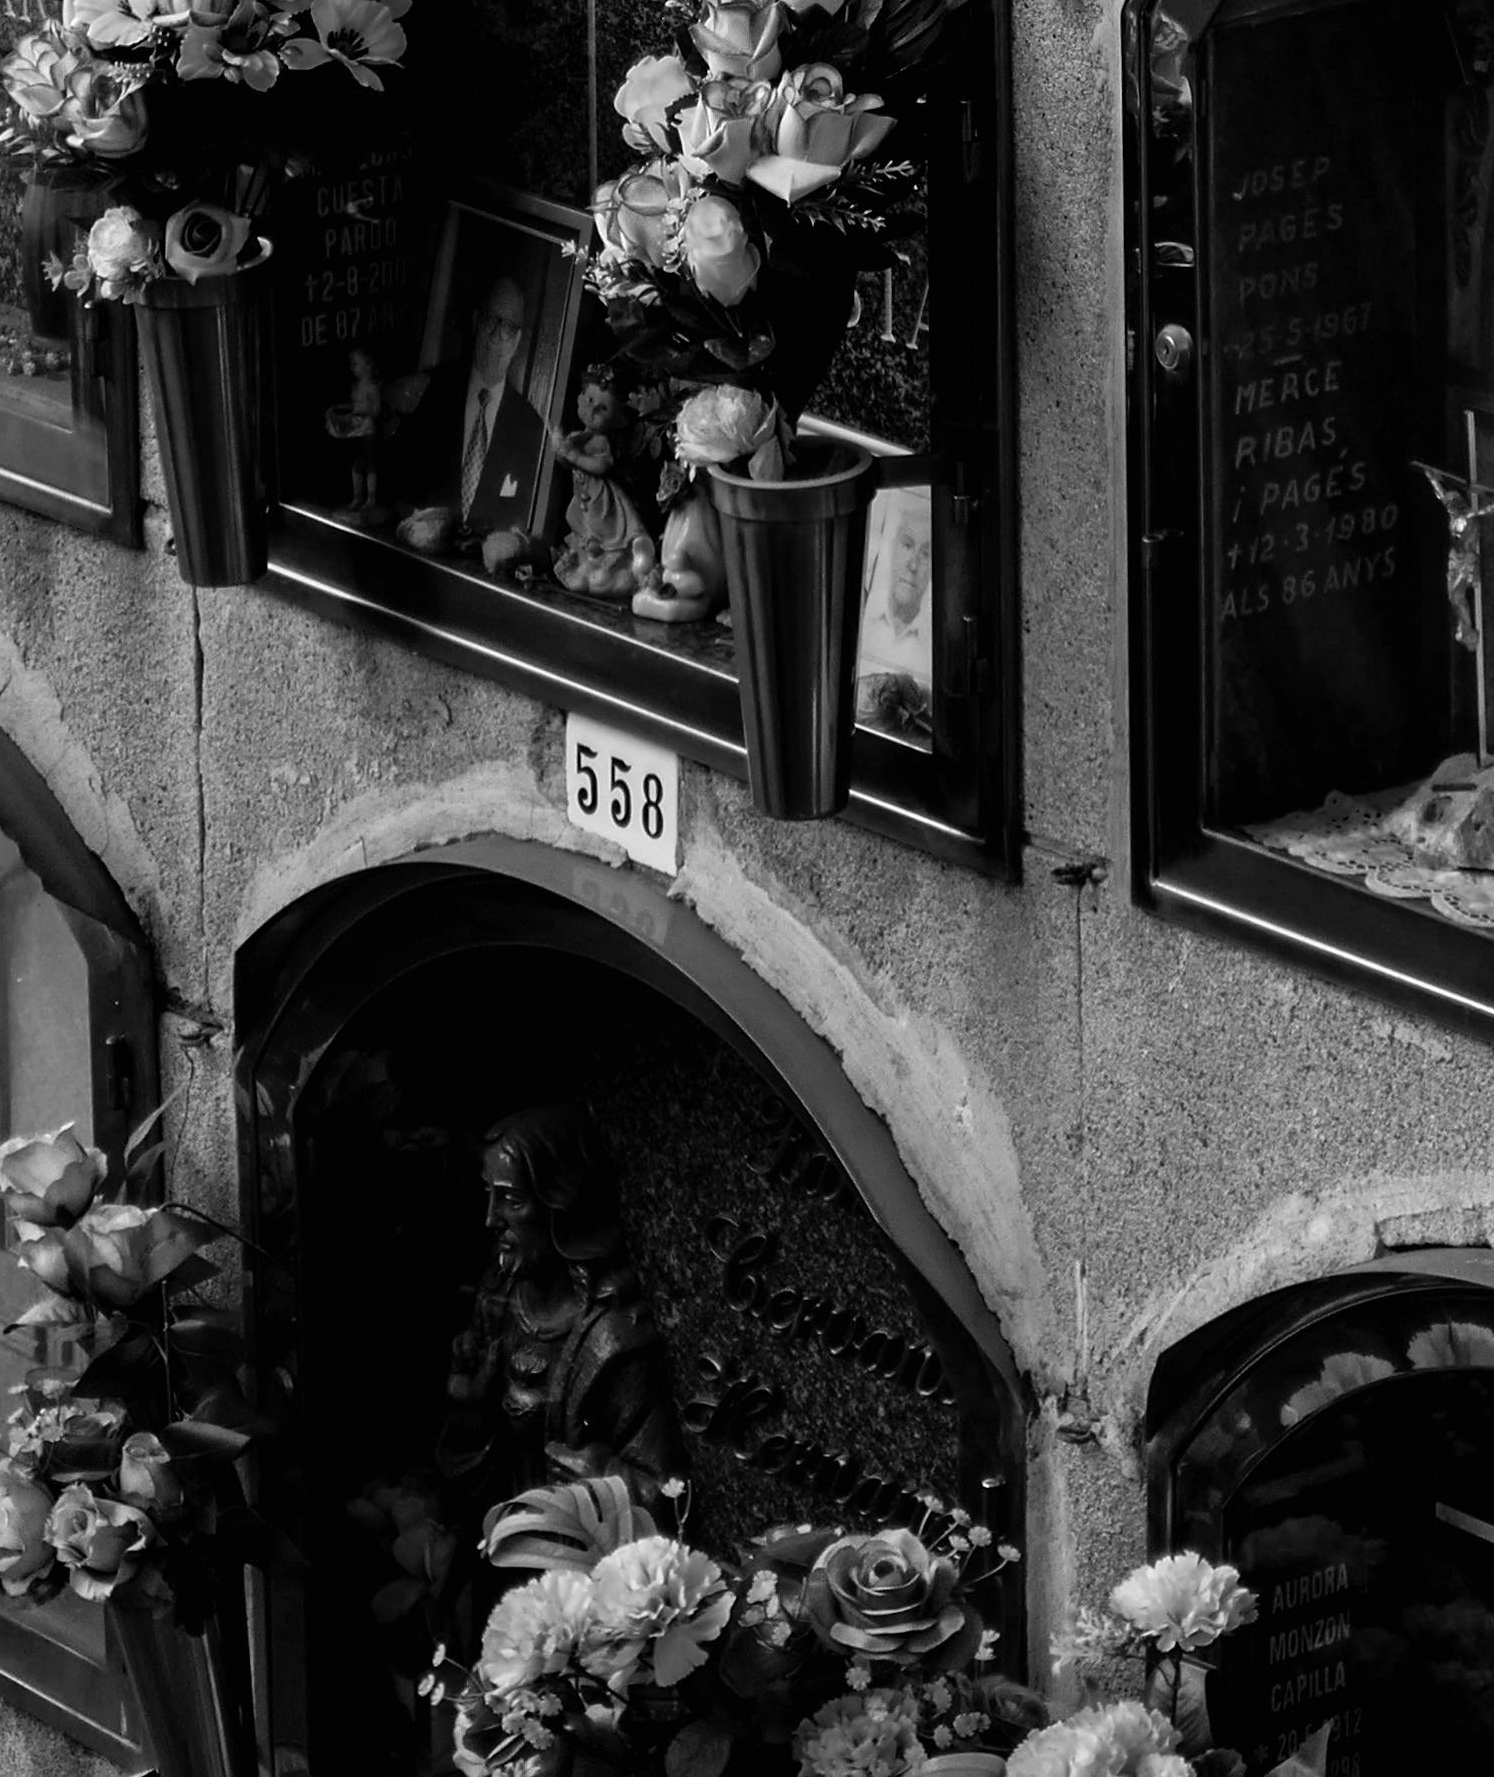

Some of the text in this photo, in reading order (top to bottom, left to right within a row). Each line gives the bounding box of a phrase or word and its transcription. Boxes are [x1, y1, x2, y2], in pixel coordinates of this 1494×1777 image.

[317, 174, 404, 218] CUESTA
[1231, 155, 1331, 203] JOSEP
[1238, 261, 1320, 307] PONS
[300, 313, 328, 348] DE
[1235, 359, 1345, 416] MERCE
[1220, 545, 1398, 623] ALS 86 ANYS
[576, 745, 664, 839] 558
[1271, 1562, 1349, 1614] AURORA
[1269, 1609, 1352, 1666] MONZON
[1270, 1660, 1347, 1713] CAPILLA
